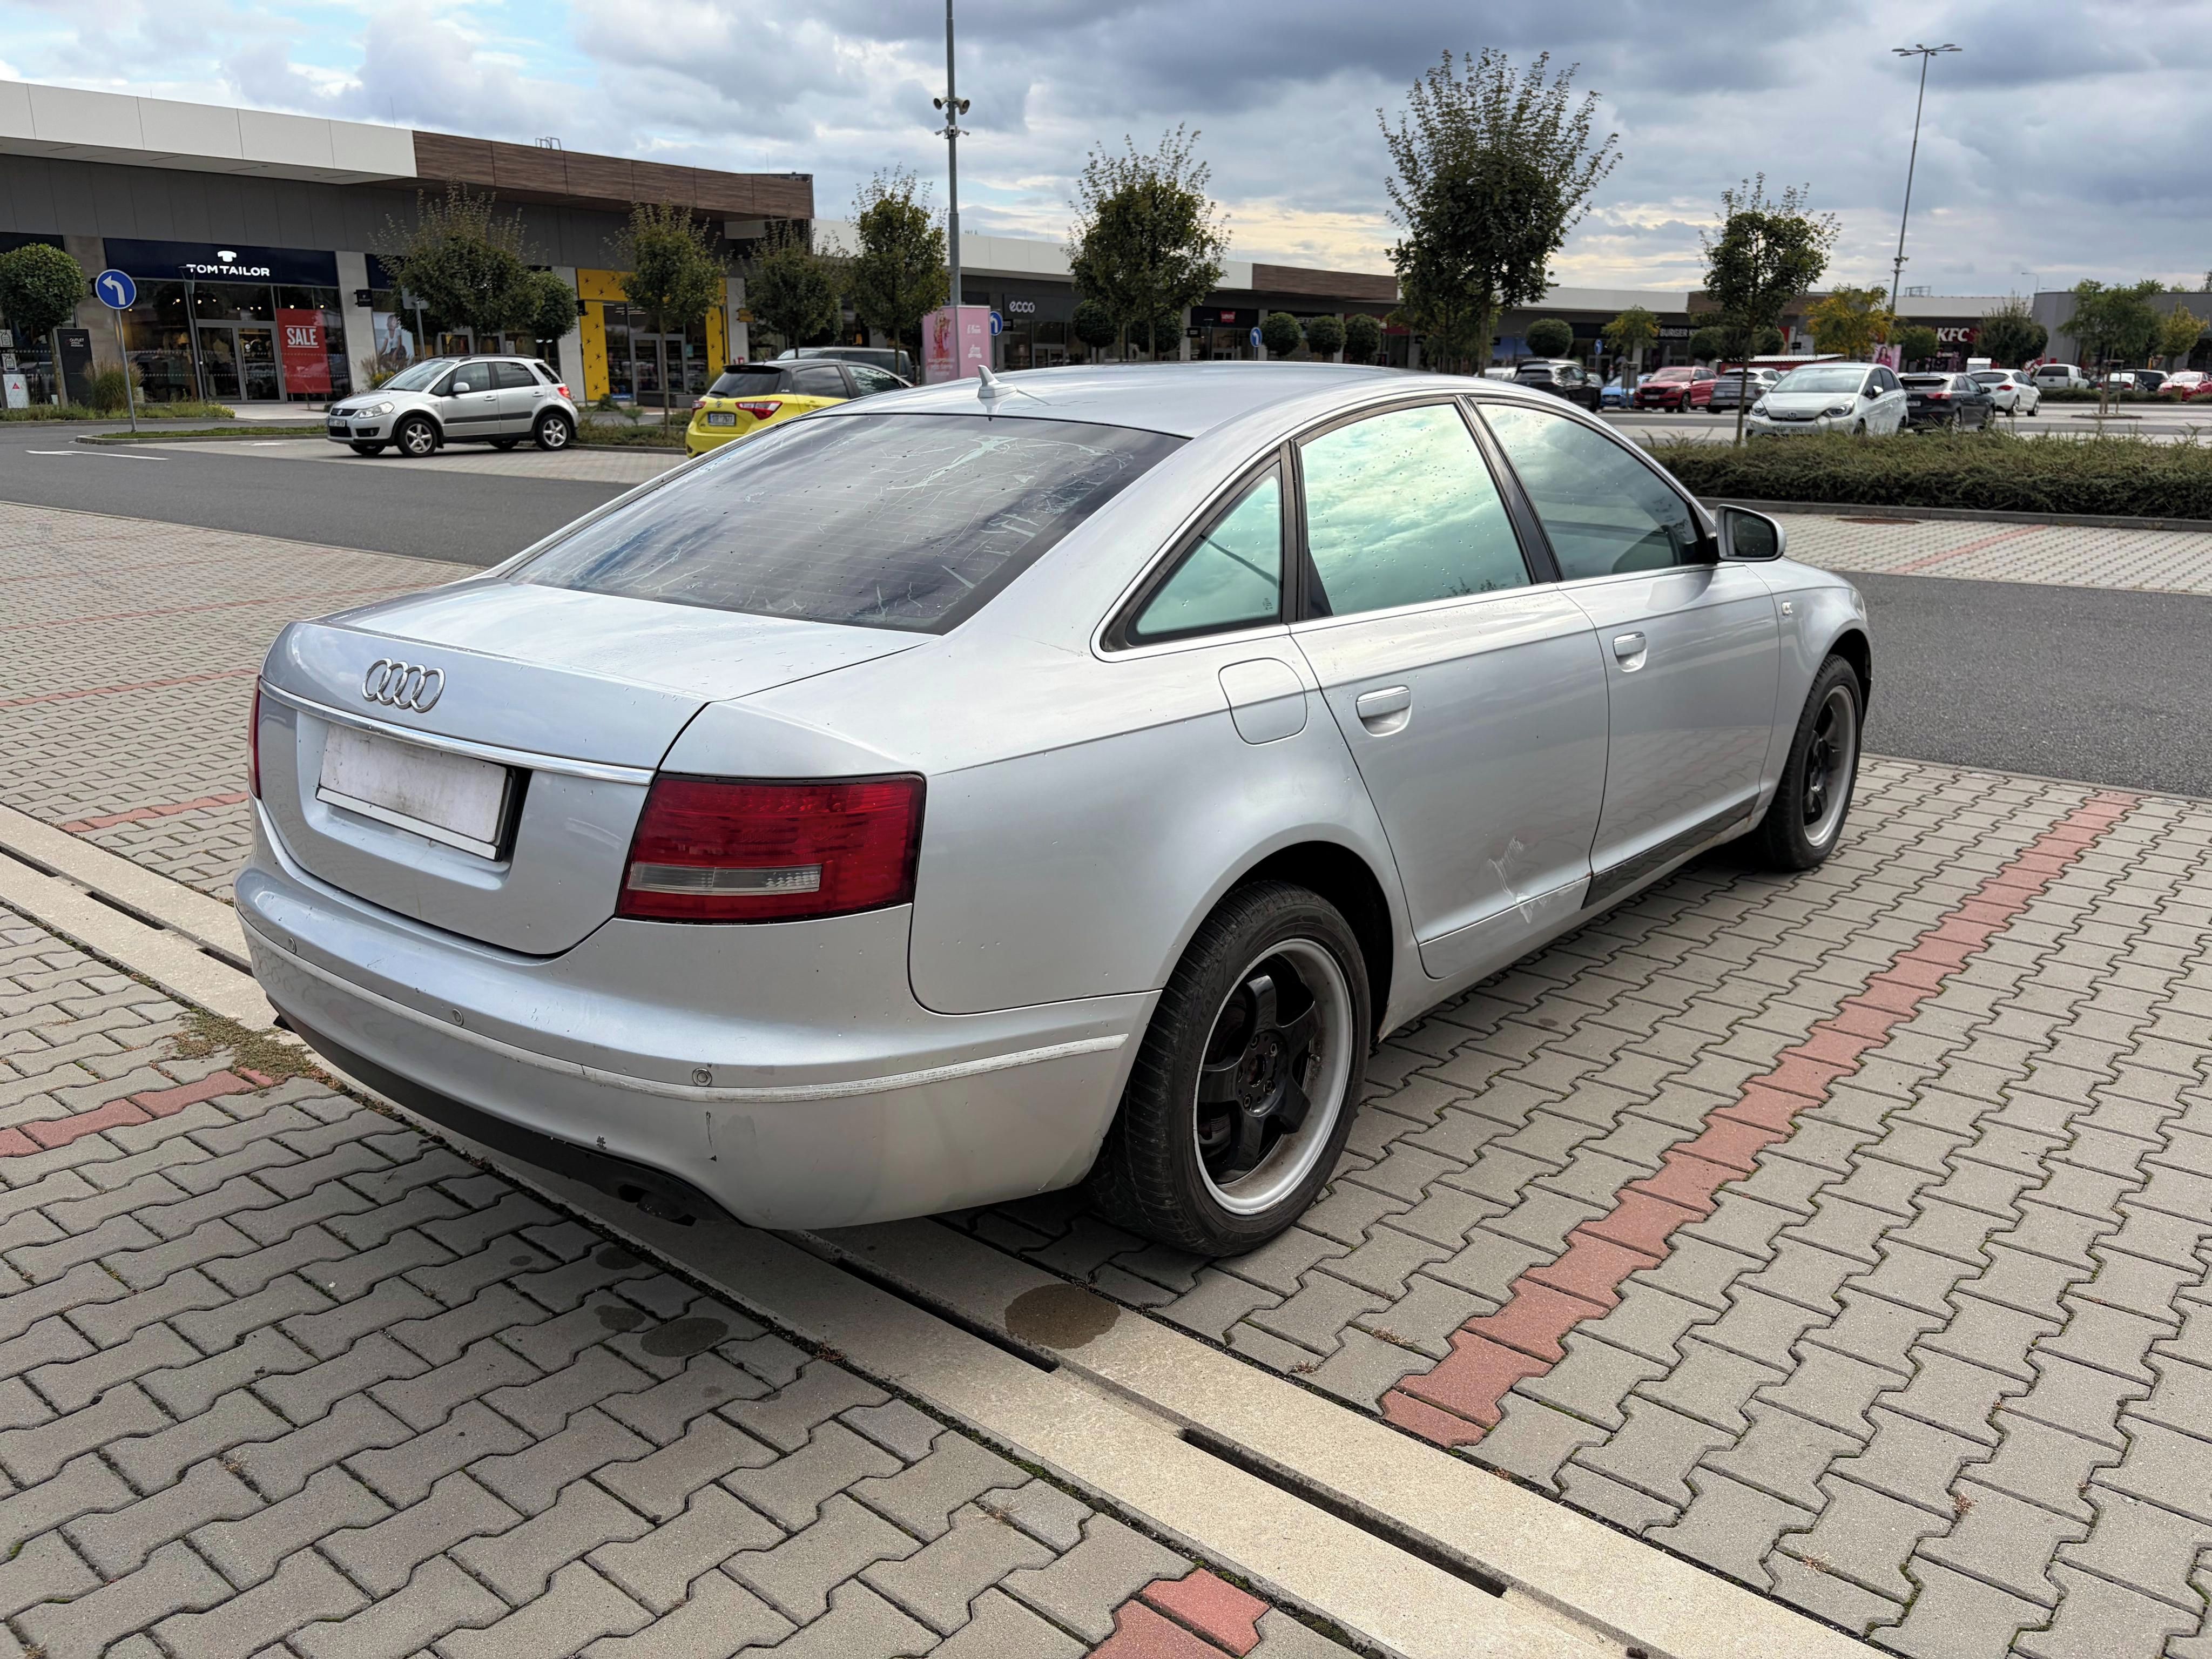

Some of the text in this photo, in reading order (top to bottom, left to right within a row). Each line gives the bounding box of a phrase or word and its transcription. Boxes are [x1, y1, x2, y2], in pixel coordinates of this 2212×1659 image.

[186, 264, 270, 276] TOM TAILOR
[1009, 301, 1035, 313] ecco
[286, 327, 318, 346] SALE
[1660, 328, 1688, 337] BURGER
[1937, 327, 1970, 342] KFC
